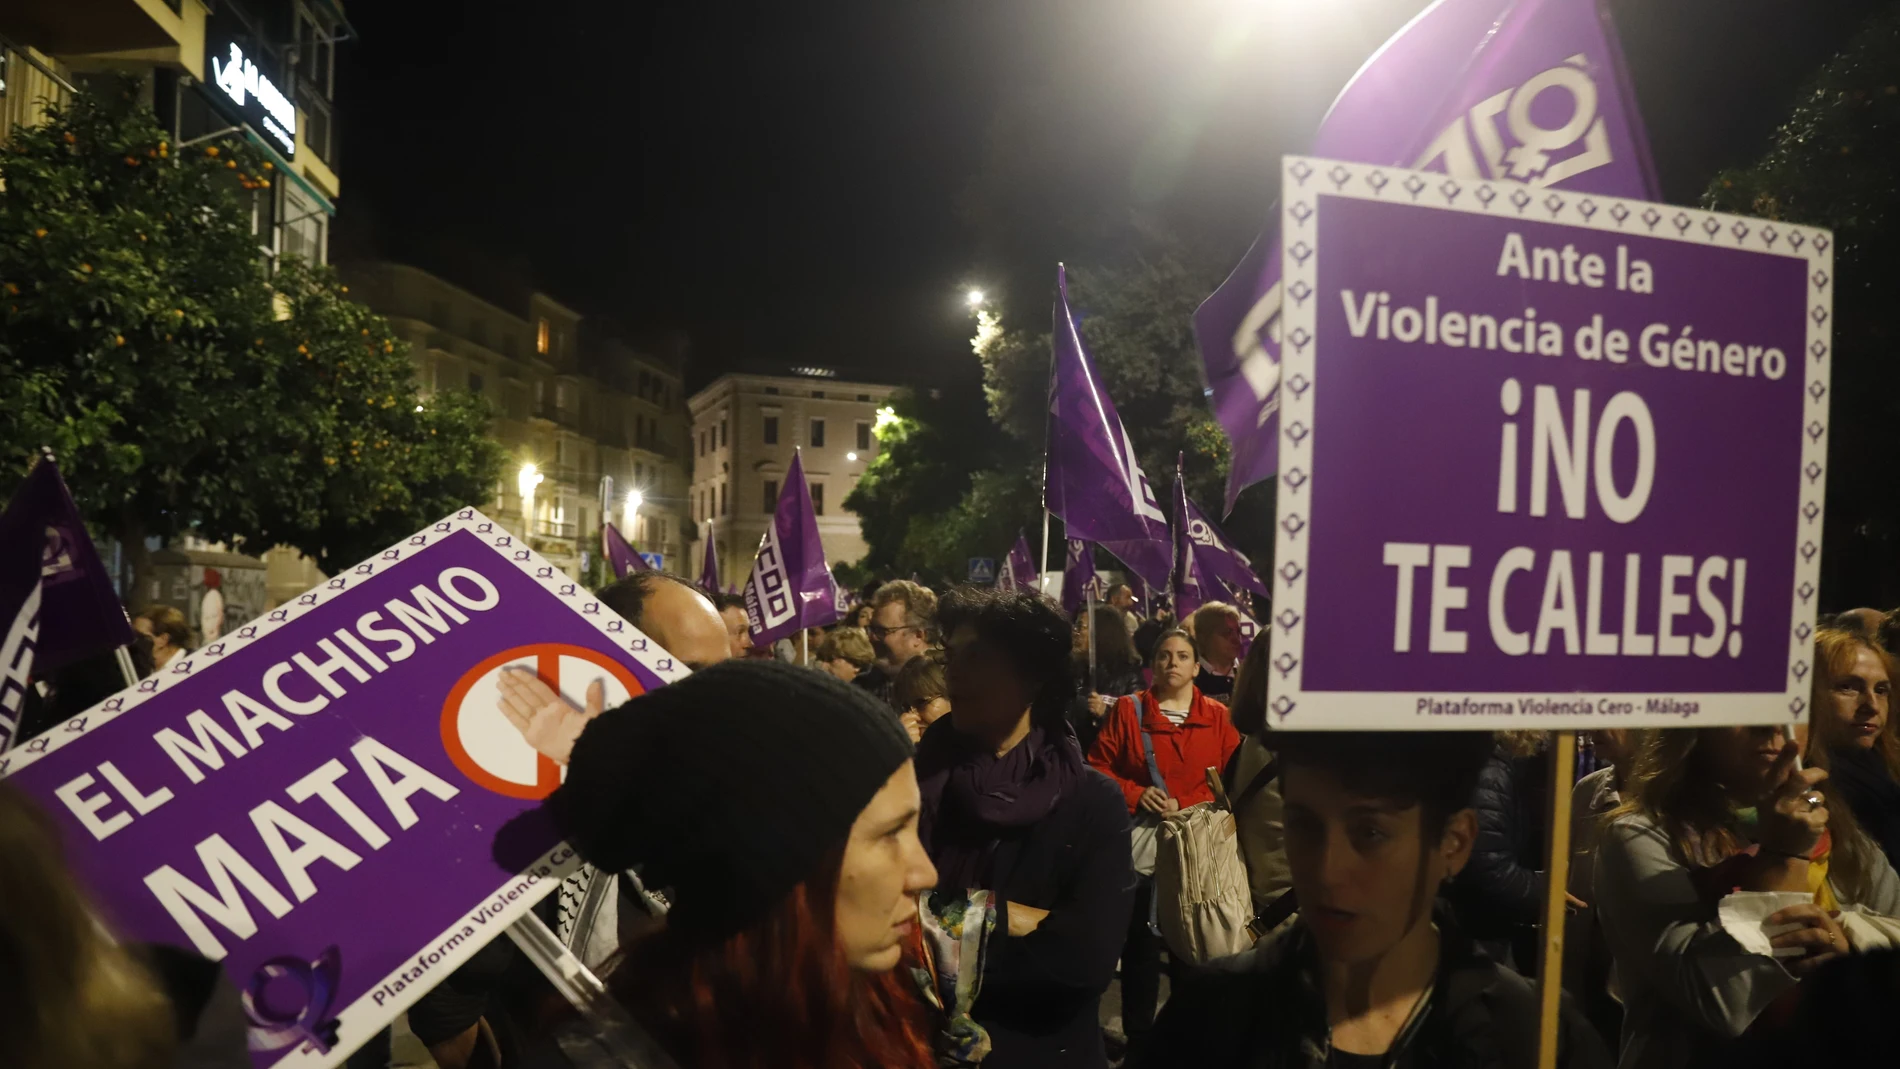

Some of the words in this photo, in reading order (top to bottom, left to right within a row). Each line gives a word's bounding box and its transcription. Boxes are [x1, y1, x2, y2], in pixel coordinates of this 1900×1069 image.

[1497, 232, 1605, 288] Ante
[1616, 245, 1654, 294] la
[1340, 290, 1563, 357] Violencia
[1574, 314, 1630, 363] de
[1639, 323, 1787, 380] Género
[1497, 377, 1657, 524] ¡NO
[745, 581, 763, 635] Málaga
[1383, 542, 1471, 653] TE
[1487, 546, 1747, 659] CALLES!
[53, 760, 175, 841] EL
[152, 566, 500, 785] MACHISMO
[1415, 697, 1514, 716] Plataforma
[1517, 697, 1593, 716] Violencia
[1597, 698, 1633, 716] Cero
[1645, 697, 1699, 719] Málaga
[142, 735, 461, 962] MATA
[372, 925, 475, 1007] Plataforma
[472, 865, 551, 926] Violencia
[550, 848, 574, 867] Ce
